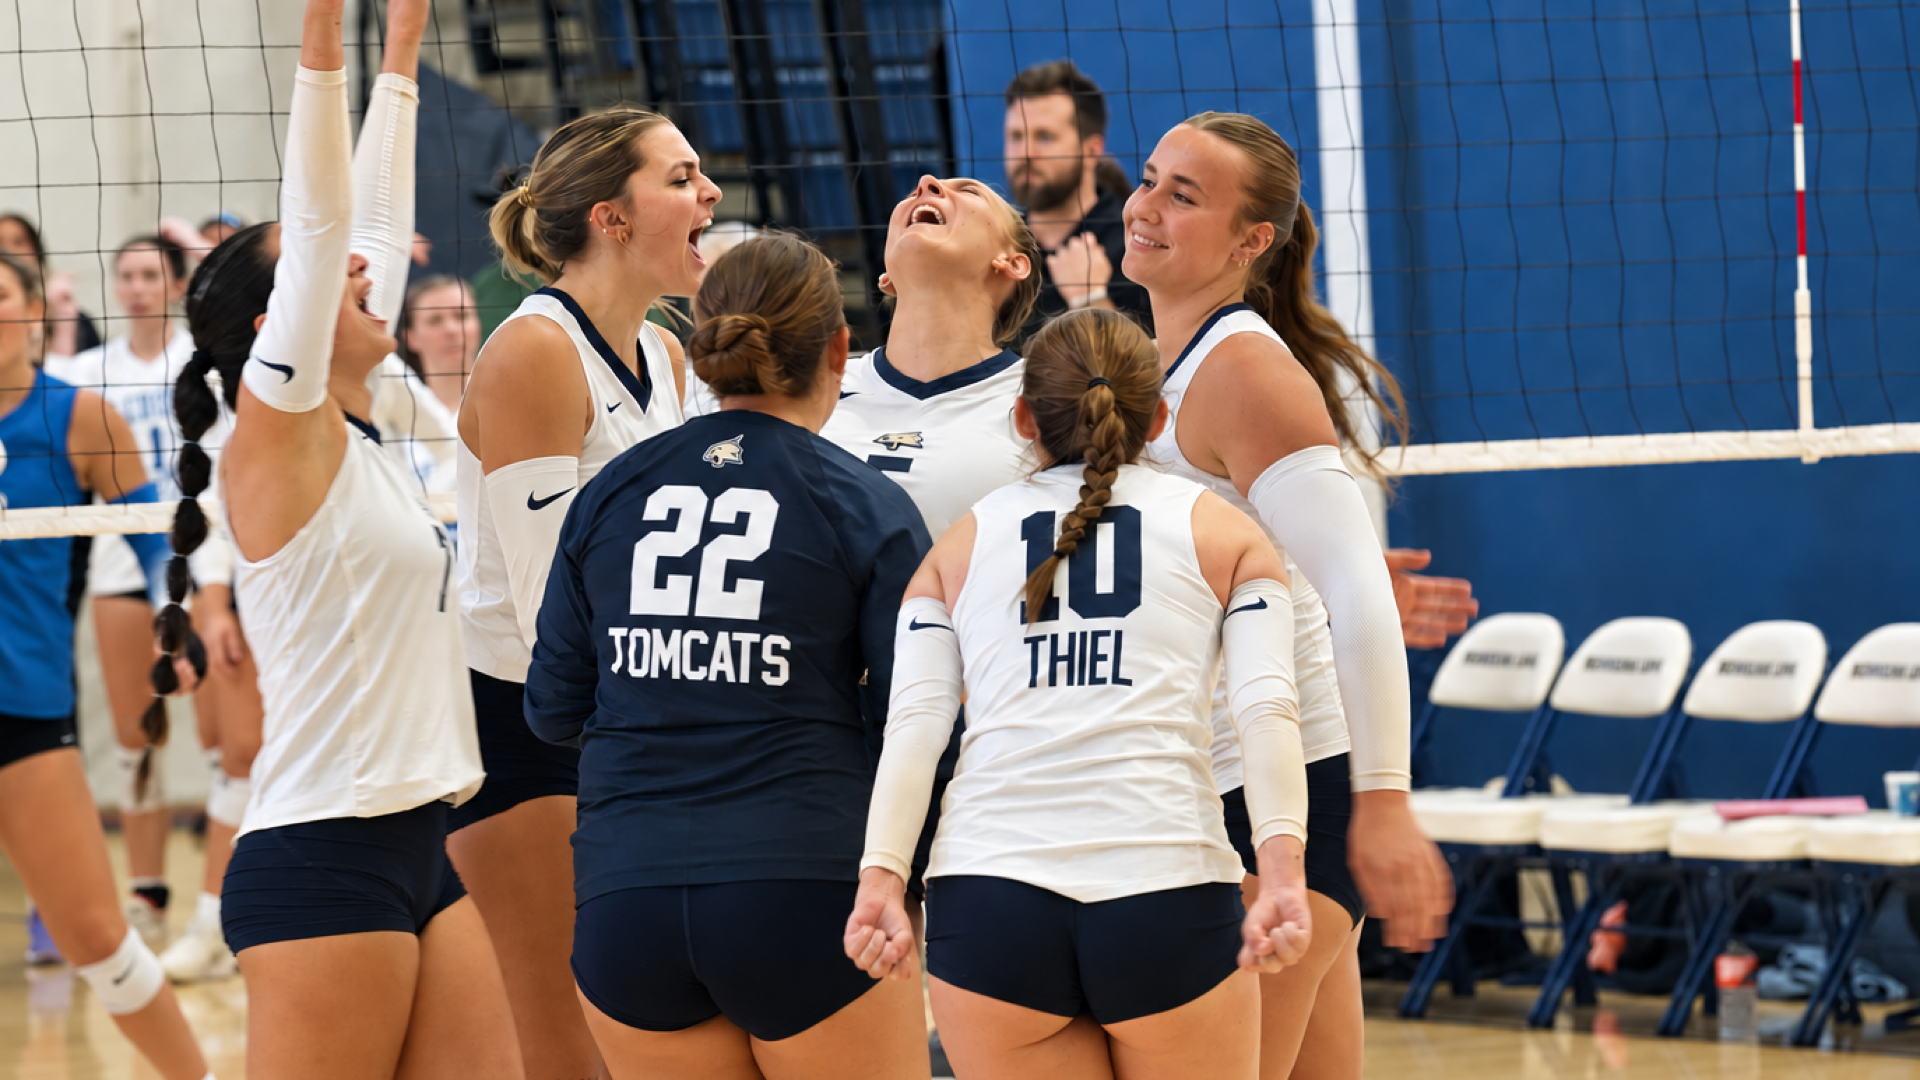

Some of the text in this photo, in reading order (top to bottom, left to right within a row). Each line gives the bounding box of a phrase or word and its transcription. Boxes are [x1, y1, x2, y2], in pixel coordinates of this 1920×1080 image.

[629, 484, 780, 621] 22
[1020, 504, 1142, 625] 10
[608, 626, 791, 687] TOMCATS
[1023, 629, 1133, 689] THIEL
